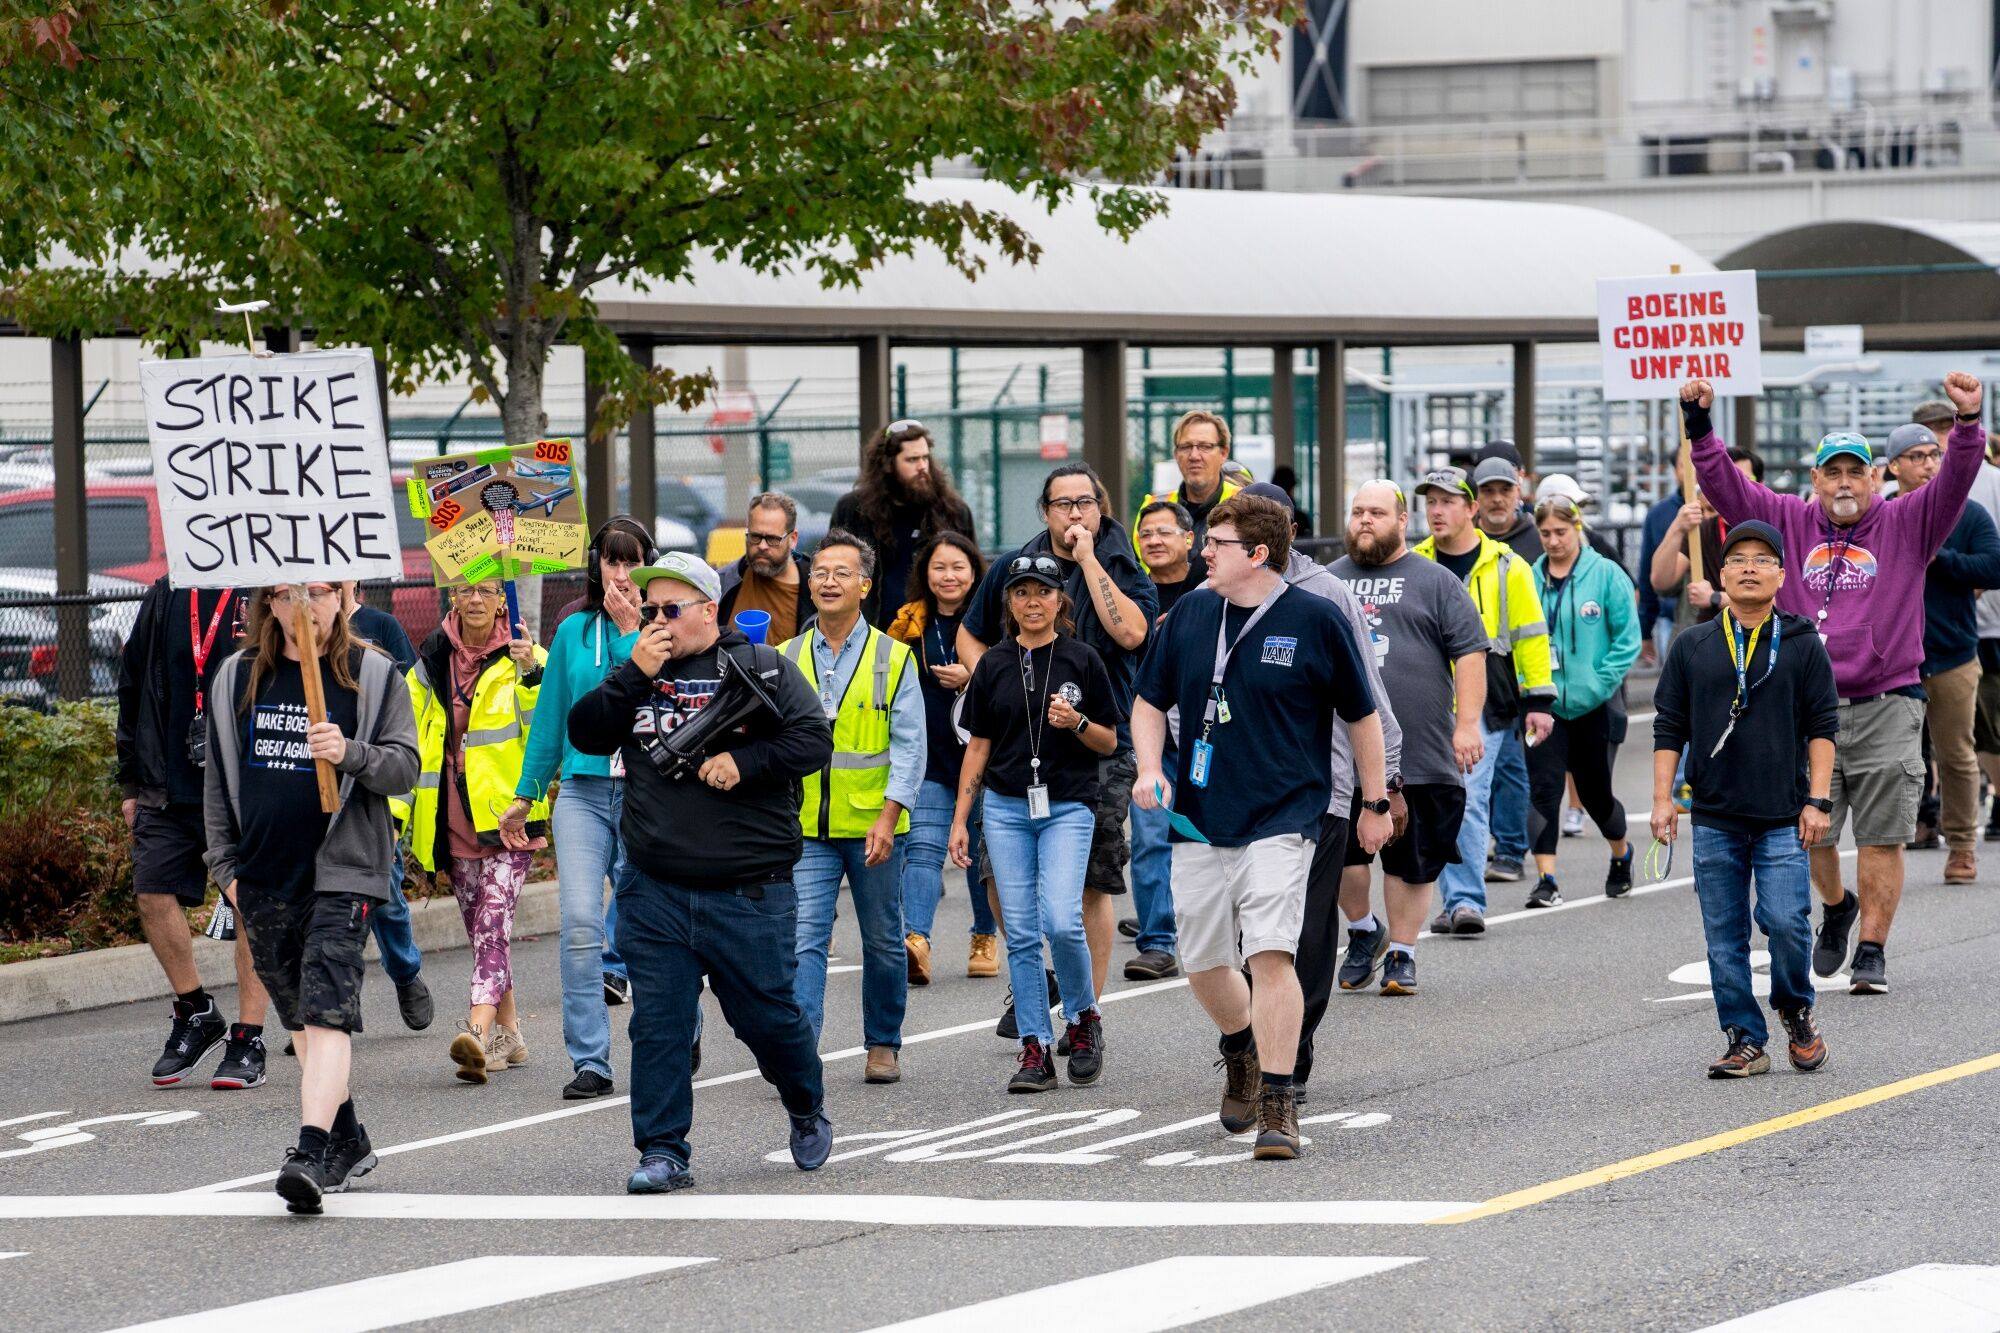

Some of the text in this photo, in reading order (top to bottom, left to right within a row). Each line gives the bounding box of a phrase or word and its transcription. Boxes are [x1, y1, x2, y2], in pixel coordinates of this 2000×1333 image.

[1627, 291, 1726, 321] BOEING
[1614, 322, 1744, 349] COMPANY
[1630, 353, 1731, 379] UNFAIR
[155, 372, 365, 431] STRIKE
[535, 442, 569, 461] SOS
[167, 437, 372, 500] STRIKE
[430, 500, 461, 529] SOS
[185, 512, 392, 572] STRIKE
[465, 558, 493, 578] COUNTER
[1364, 593, 1403, 605] TODAY
[1262, 645, 1295, 664] IAM
[256, 712, 286, 731] MAKE
[254, 738, 285, 756] GREAT
